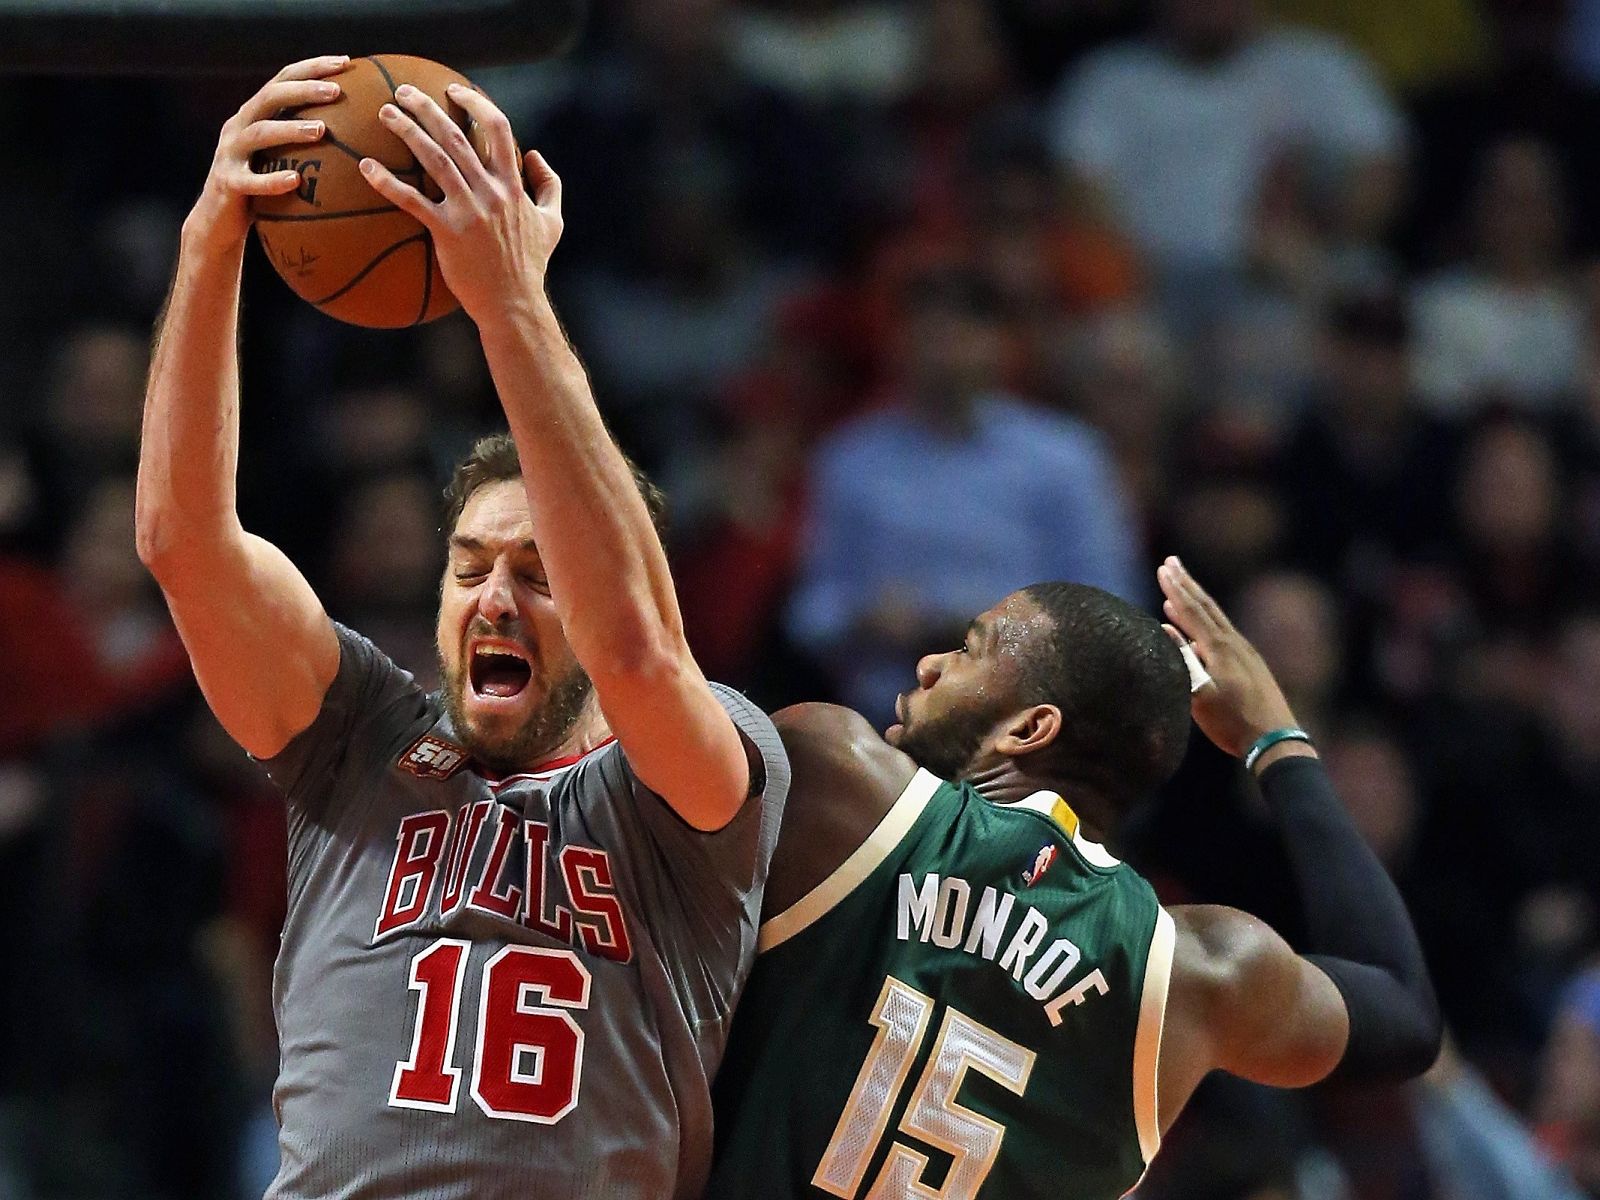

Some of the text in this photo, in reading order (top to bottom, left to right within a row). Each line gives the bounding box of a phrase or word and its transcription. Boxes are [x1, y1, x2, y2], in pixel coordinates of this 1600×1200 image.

[409, 741, 461, 771] 50
[372, 799, 633, 964] BULLS
[897, 873, 1109, 1027] MONROE
[388, 938, 592, 1125] 16
[811, 974, 1037, 1200] 15
